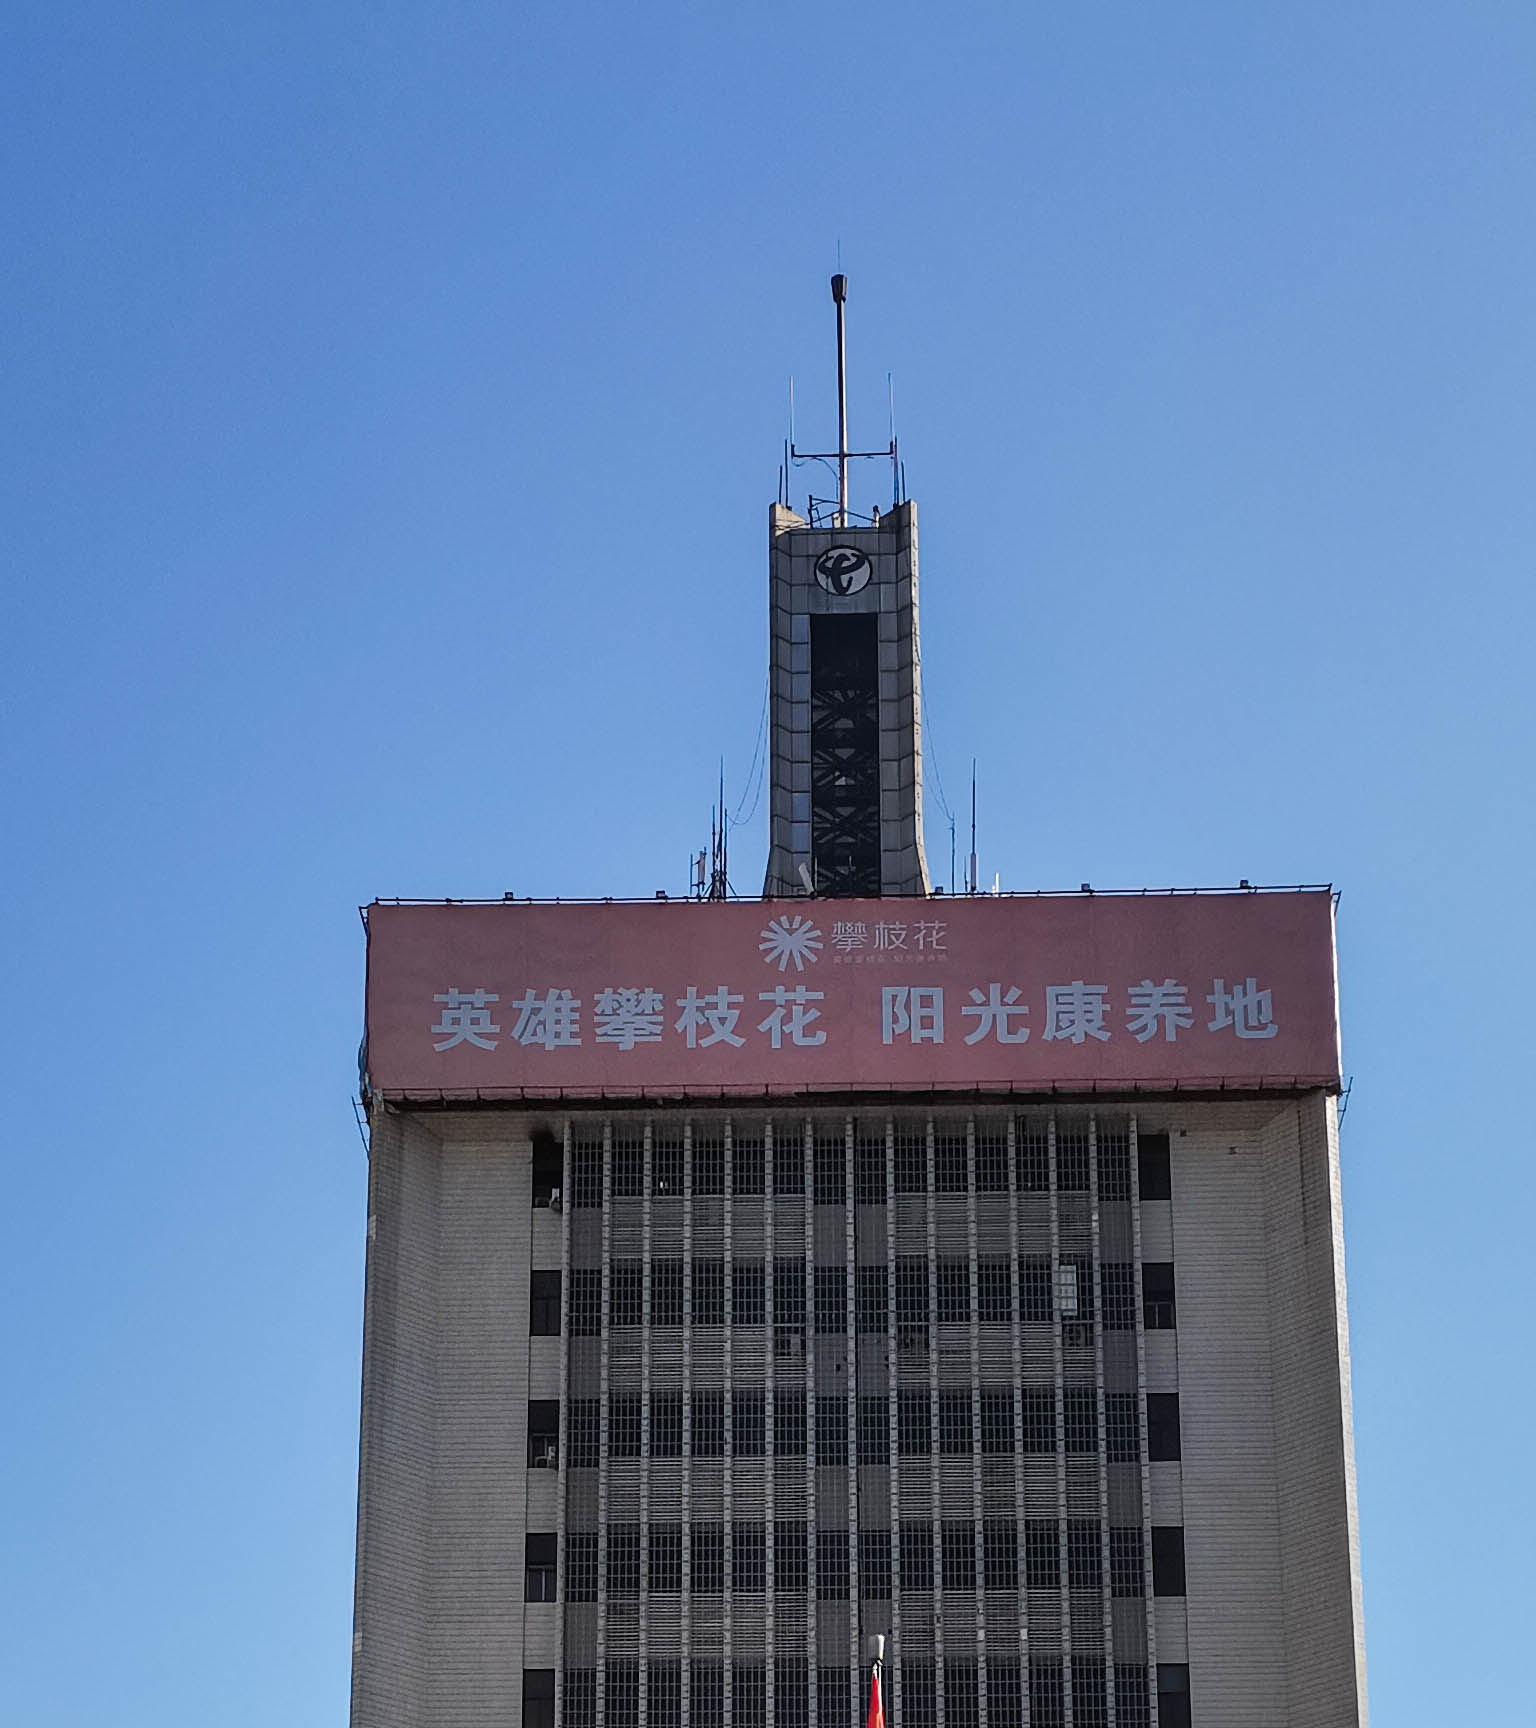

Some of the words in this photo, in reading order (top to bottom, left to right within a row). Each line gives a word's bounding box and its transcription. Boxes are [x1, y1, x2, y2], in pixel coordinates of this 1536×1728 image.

[831, 919, 948, 952] 攀枝花
[431, 984, 828, 1053] 英雄攀枝花
[880, 977, 1279, 1047] 阳光康养地
